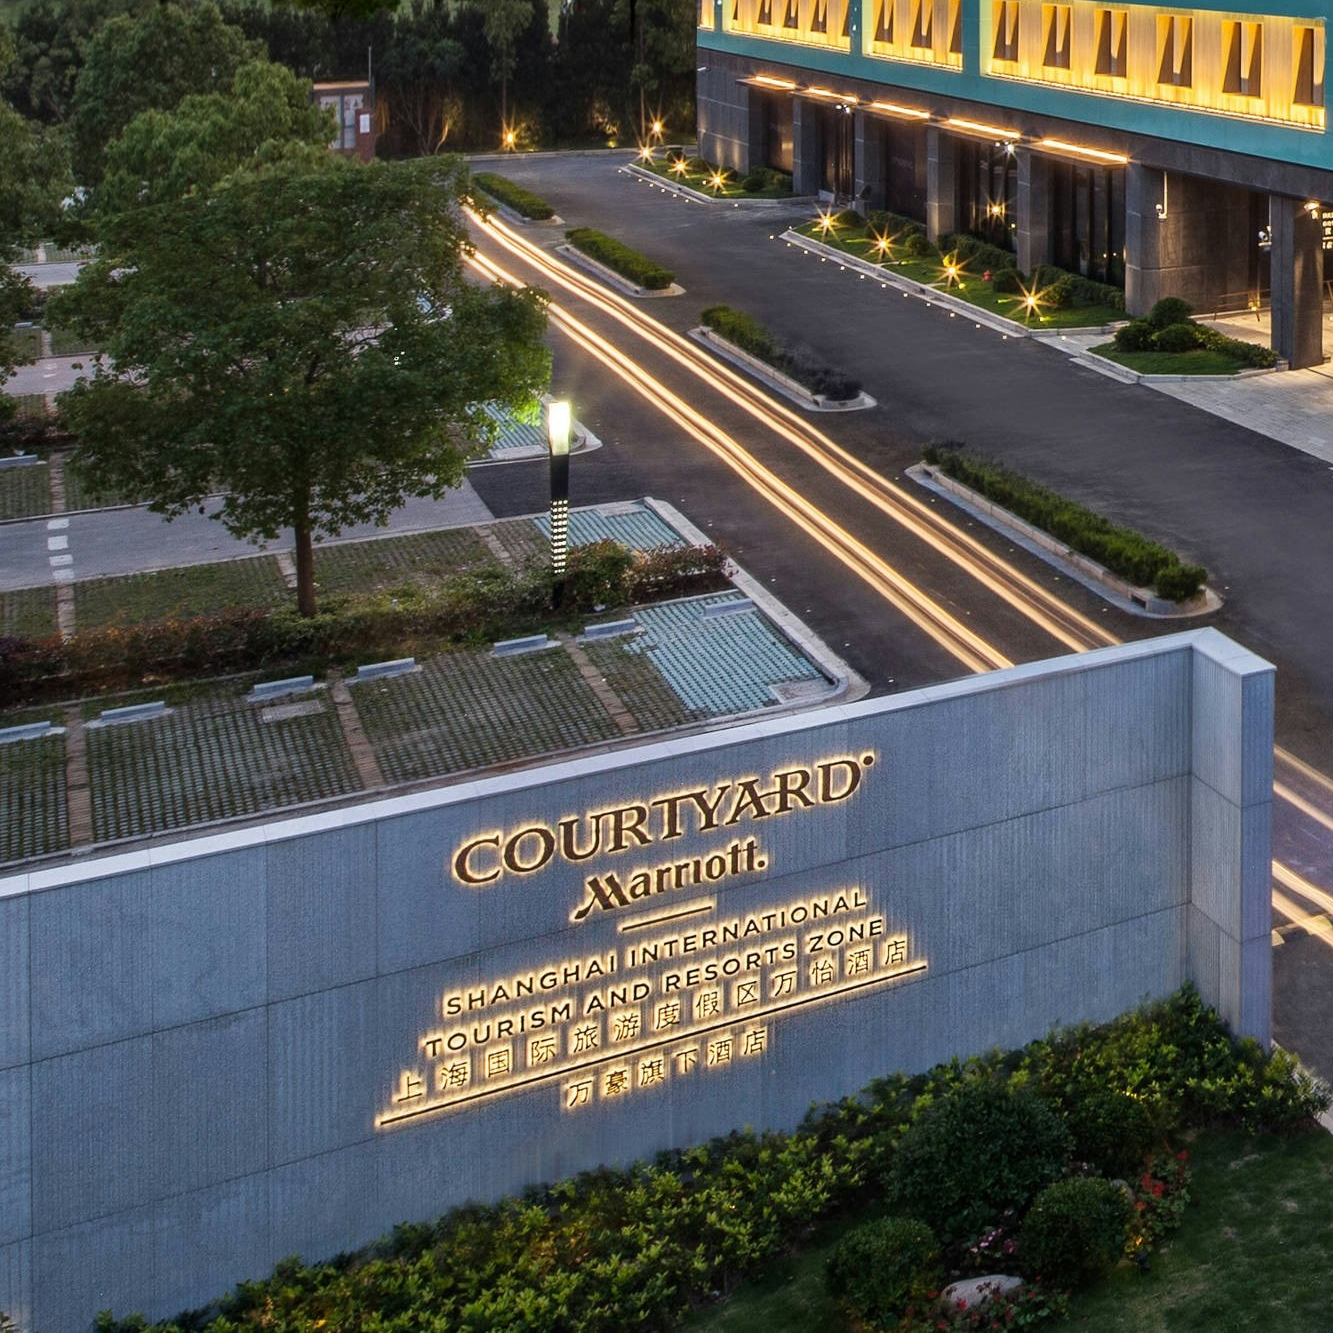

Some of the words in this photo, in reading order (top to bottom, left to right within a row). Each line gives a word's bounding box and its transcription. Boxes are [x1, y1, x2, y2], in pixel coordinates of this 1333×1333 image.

[426, 1003, 570, 1057] TOURISM
[586, 983, 650, 1014] AND
[665, 943, 796, 992] RESORTS
[809, 919, 883, 953] ZONE
[446, 955, 615, 1015] SHANGHAI
[630, 892, 867, 967] INTERNATIONAL
[397, 939, 906, 1102] 上海国际旅游度假区万怡酒店
[568, 1030, 766, 1107] 万豪旗下酒店
